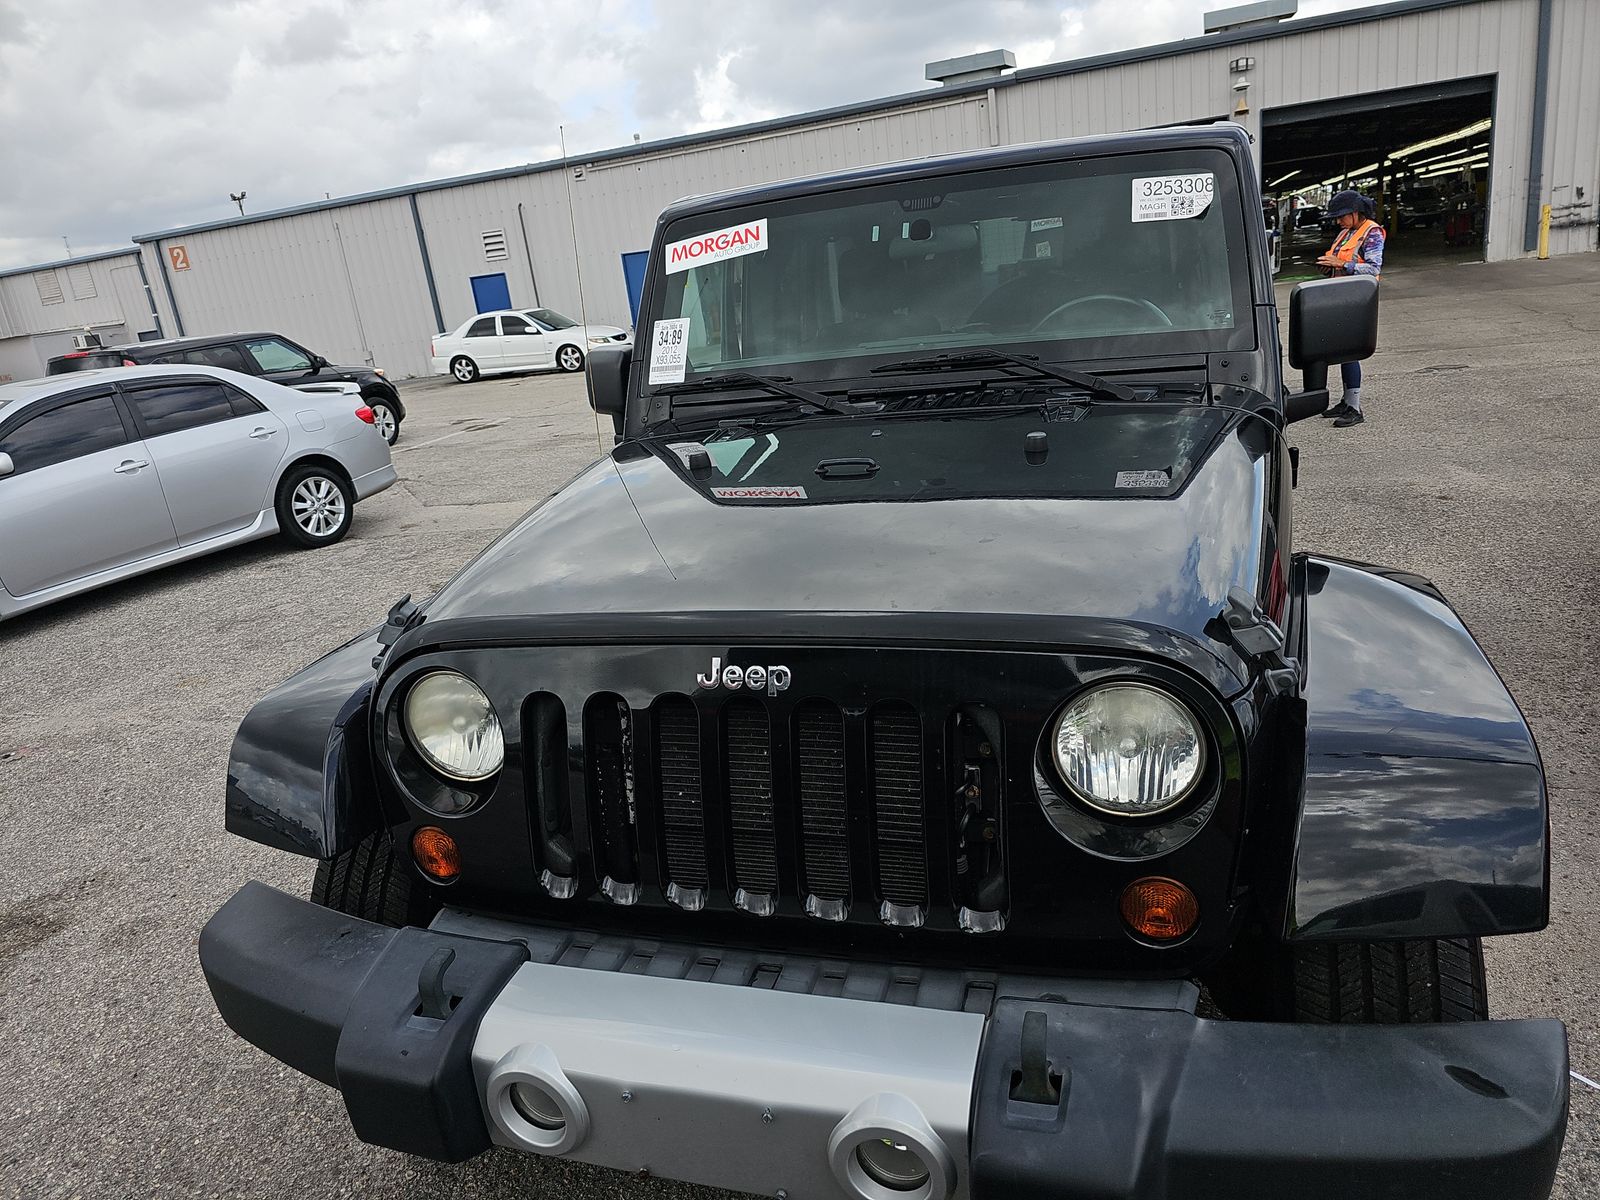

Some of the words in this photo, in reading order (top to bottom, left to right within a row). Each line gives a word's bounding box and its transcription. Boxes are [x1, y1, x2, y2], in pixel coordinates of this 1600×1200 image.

[1143, 177, 1213, 196] 3253308
[671, 226, 760, 263] MORGAN
[714, 248, 733, 258] AUTO
[734, 242, 760, 254] GROUP
[173, 248, 187, 268] 2
[658, 329, 682, 346] 34:89
[661, 345, 678, 354] 2012
[697, 657, 791, 696] Jeep
